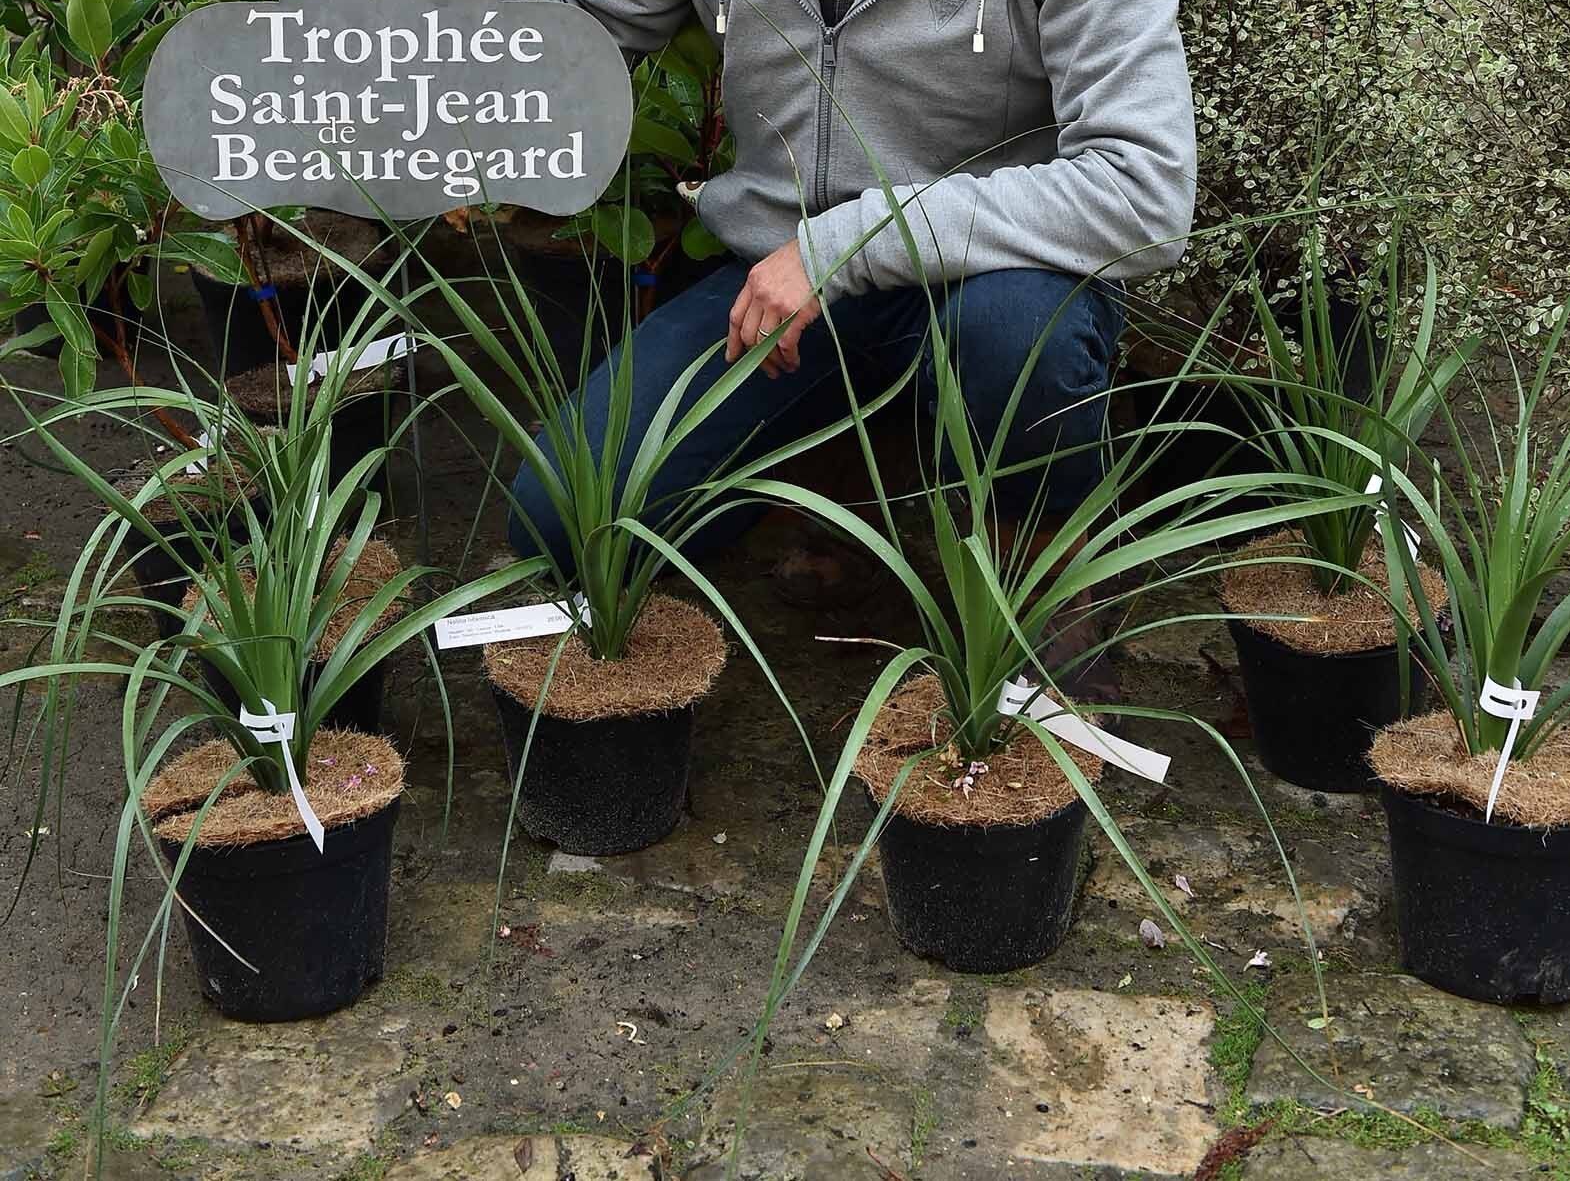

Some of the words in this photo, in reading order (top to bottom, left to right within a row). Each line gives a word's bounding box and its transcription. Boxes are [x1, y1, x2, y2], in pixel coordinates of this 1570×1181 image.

[246, 8, 544, 82] Trophée
[210, 74, 553, 142] Saint-Jean
[318, 116, 357, 144] de
[211, 130, 588, 198] Beauregard
